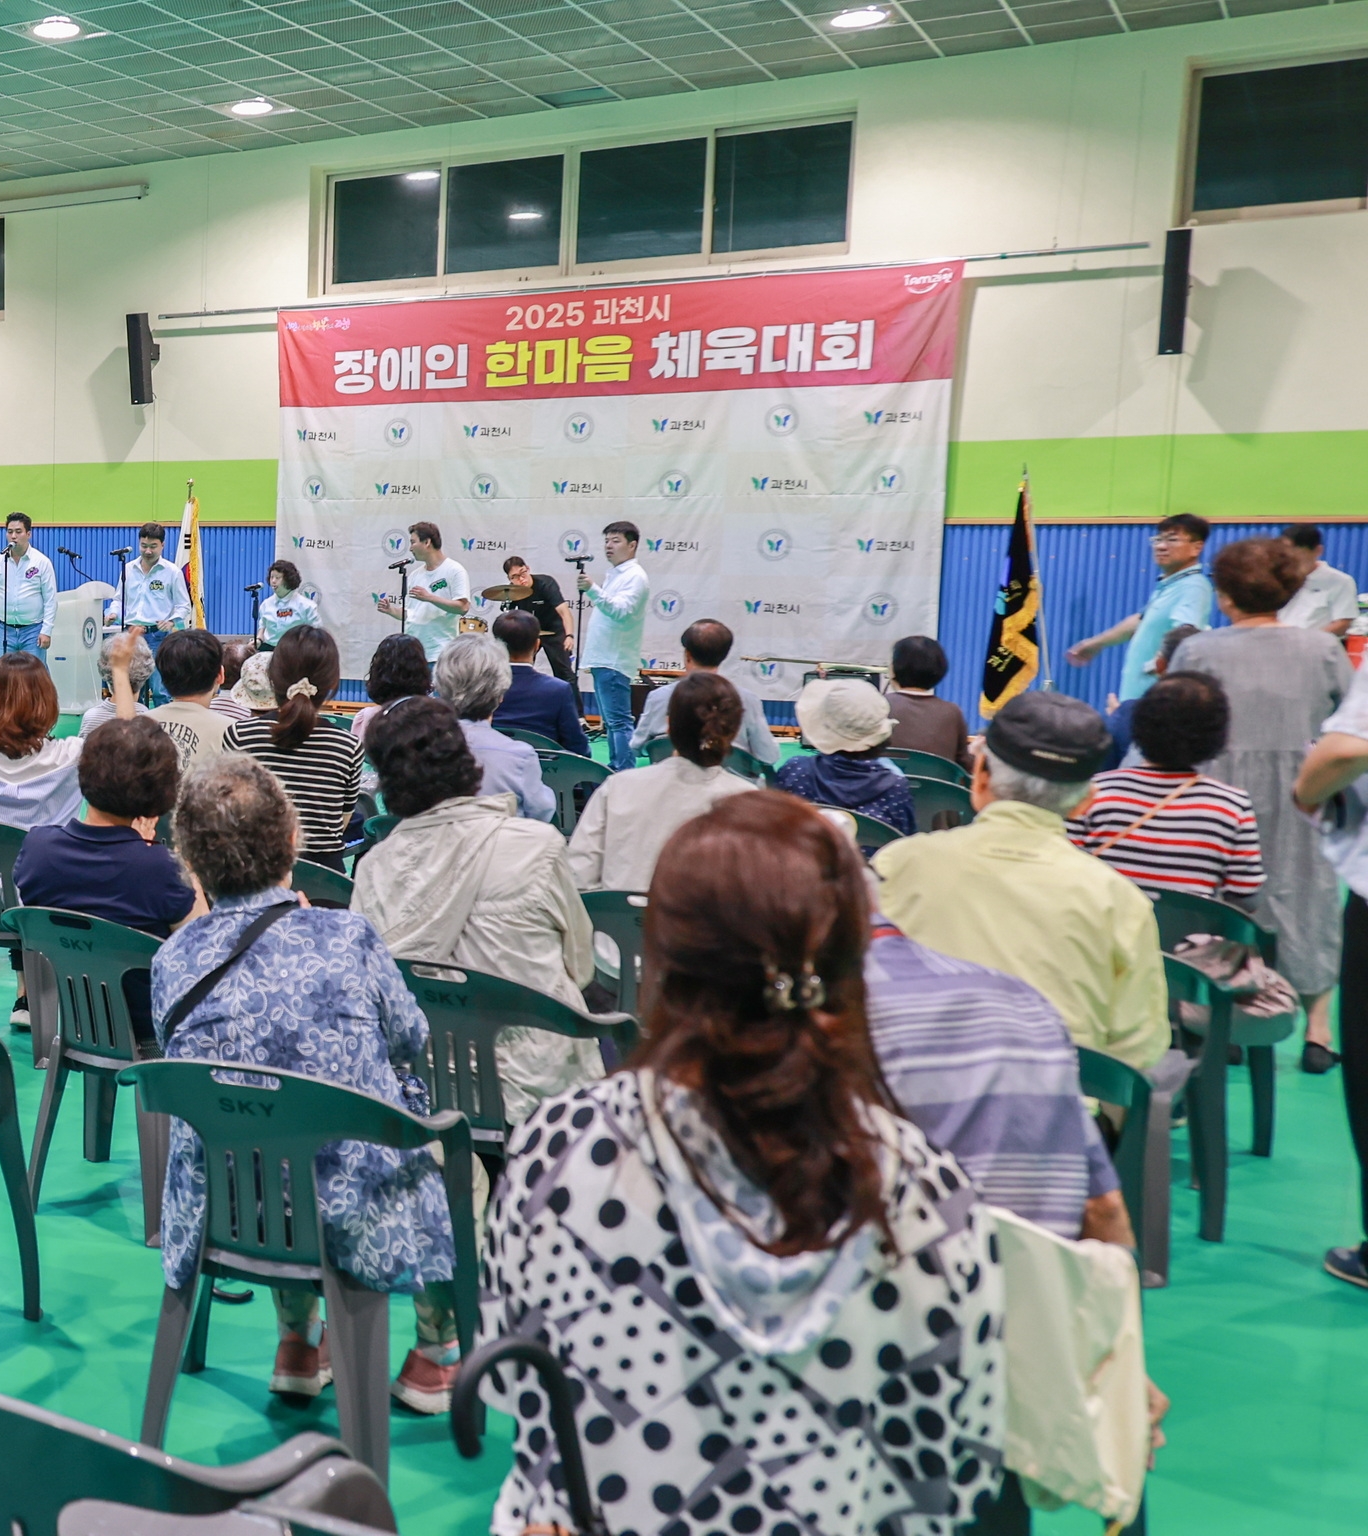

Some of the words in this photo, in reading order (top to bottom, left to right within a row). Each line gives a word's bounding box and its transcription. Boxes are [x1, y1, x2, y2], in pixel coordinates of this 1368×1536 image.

[505, 301, 585, 331] 2025
[591, 294, 671, 326] 과천시
[333, 343, 469, 394] 장애인
[485, 334, 634, 388] 한마음
[648, 319, 875, 379] 체육대회
[885, 410, 923, 423] 과천시
[669, 420, 706, 431] 과천시
[307, 431, 337, 442] 과천시
[480, 426, 511, 437] 과천시
[390, 484, 421, 495] 과천시
[569, 482, 602, 494] 과천시
[770, 479, 808, 490] 과천시
[305, 538, 334, 549] 과천시
[476, 540, 507, 551] 과천시
[664, 541, 699, 552] 과천시
[875, 540, 915, 552] 과천시
[763, 602, 800, 615] 과천시
[658, 660, 687, 670] 과천
[159, 721, 200, 755] VIBE
[540, 766, 559, 774] KY
[59, 936, 94, 953] SKY
[424, 989, 469, 1007] SKY
[218, 1097, 275, 1117] SKY
